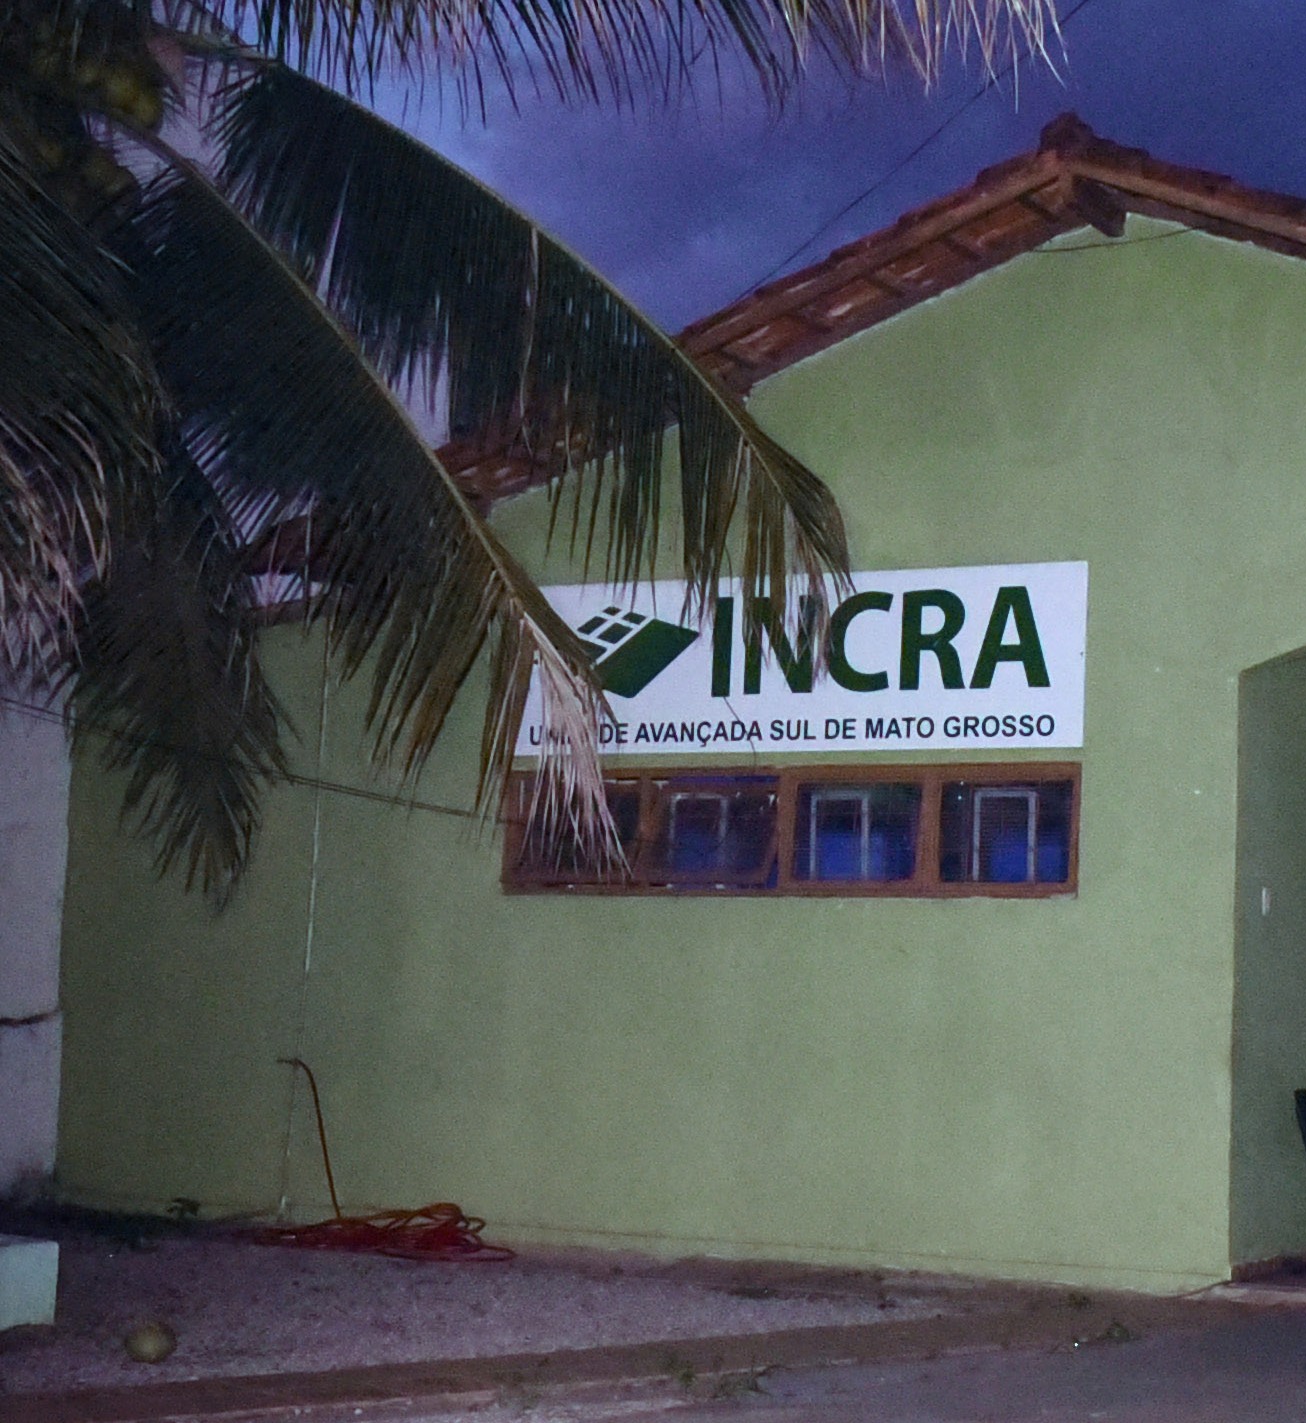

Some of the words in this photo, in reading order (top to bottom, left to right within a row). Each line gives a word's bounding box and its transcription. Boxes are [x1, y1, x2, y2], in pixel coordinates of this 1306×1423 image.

[711, 583, 1051, 697] INCRA
[634, 719, 763, 747] AVANÇADA
[769, 718, 816, 741] SUL
[824, 717, 857, 740] DE
[865, 716, 935, 739] MATO
[943, 714, 1055, 738] GROSSO
